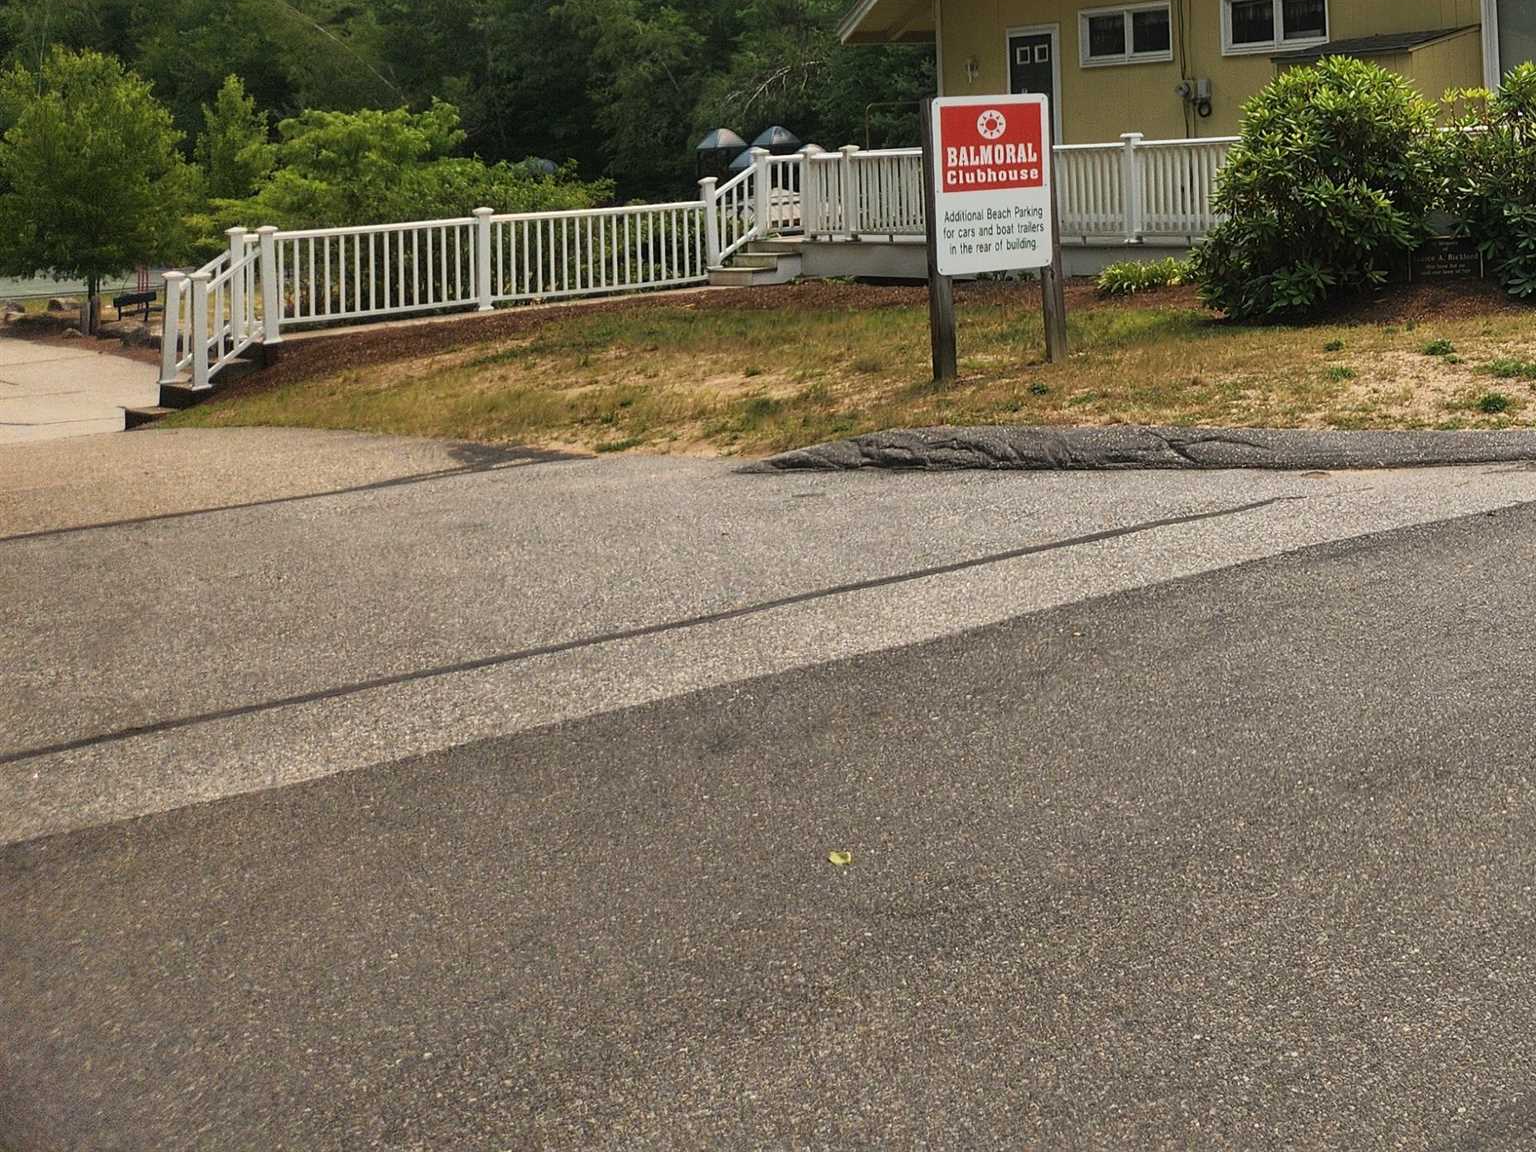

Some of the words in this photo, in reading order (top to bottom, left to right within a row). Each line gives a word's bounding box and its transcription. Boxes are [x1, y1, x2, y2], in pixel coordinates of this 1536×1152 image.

[947, 143, 1037, 167] BALMORAL
[947, 168, 1039, 184] Clubhouse
[944, 209, 984, 223] Additional
[986, 208, 1011, 220] Beach
[1014, 206, 1043, 219] Parking
[943, 227, 955, 239] for
[958, 228, 975, 238] cars
[978, 225, 993, 236] and
[996, 224, 1014, 235] boat
[1017, 222, 1044, 233] trailers
[950, 243, 957, 255] in
[960, 242, 973, 254] the
[976, 242, 992, 253] rear
[995, 239, 1003, 251] of
